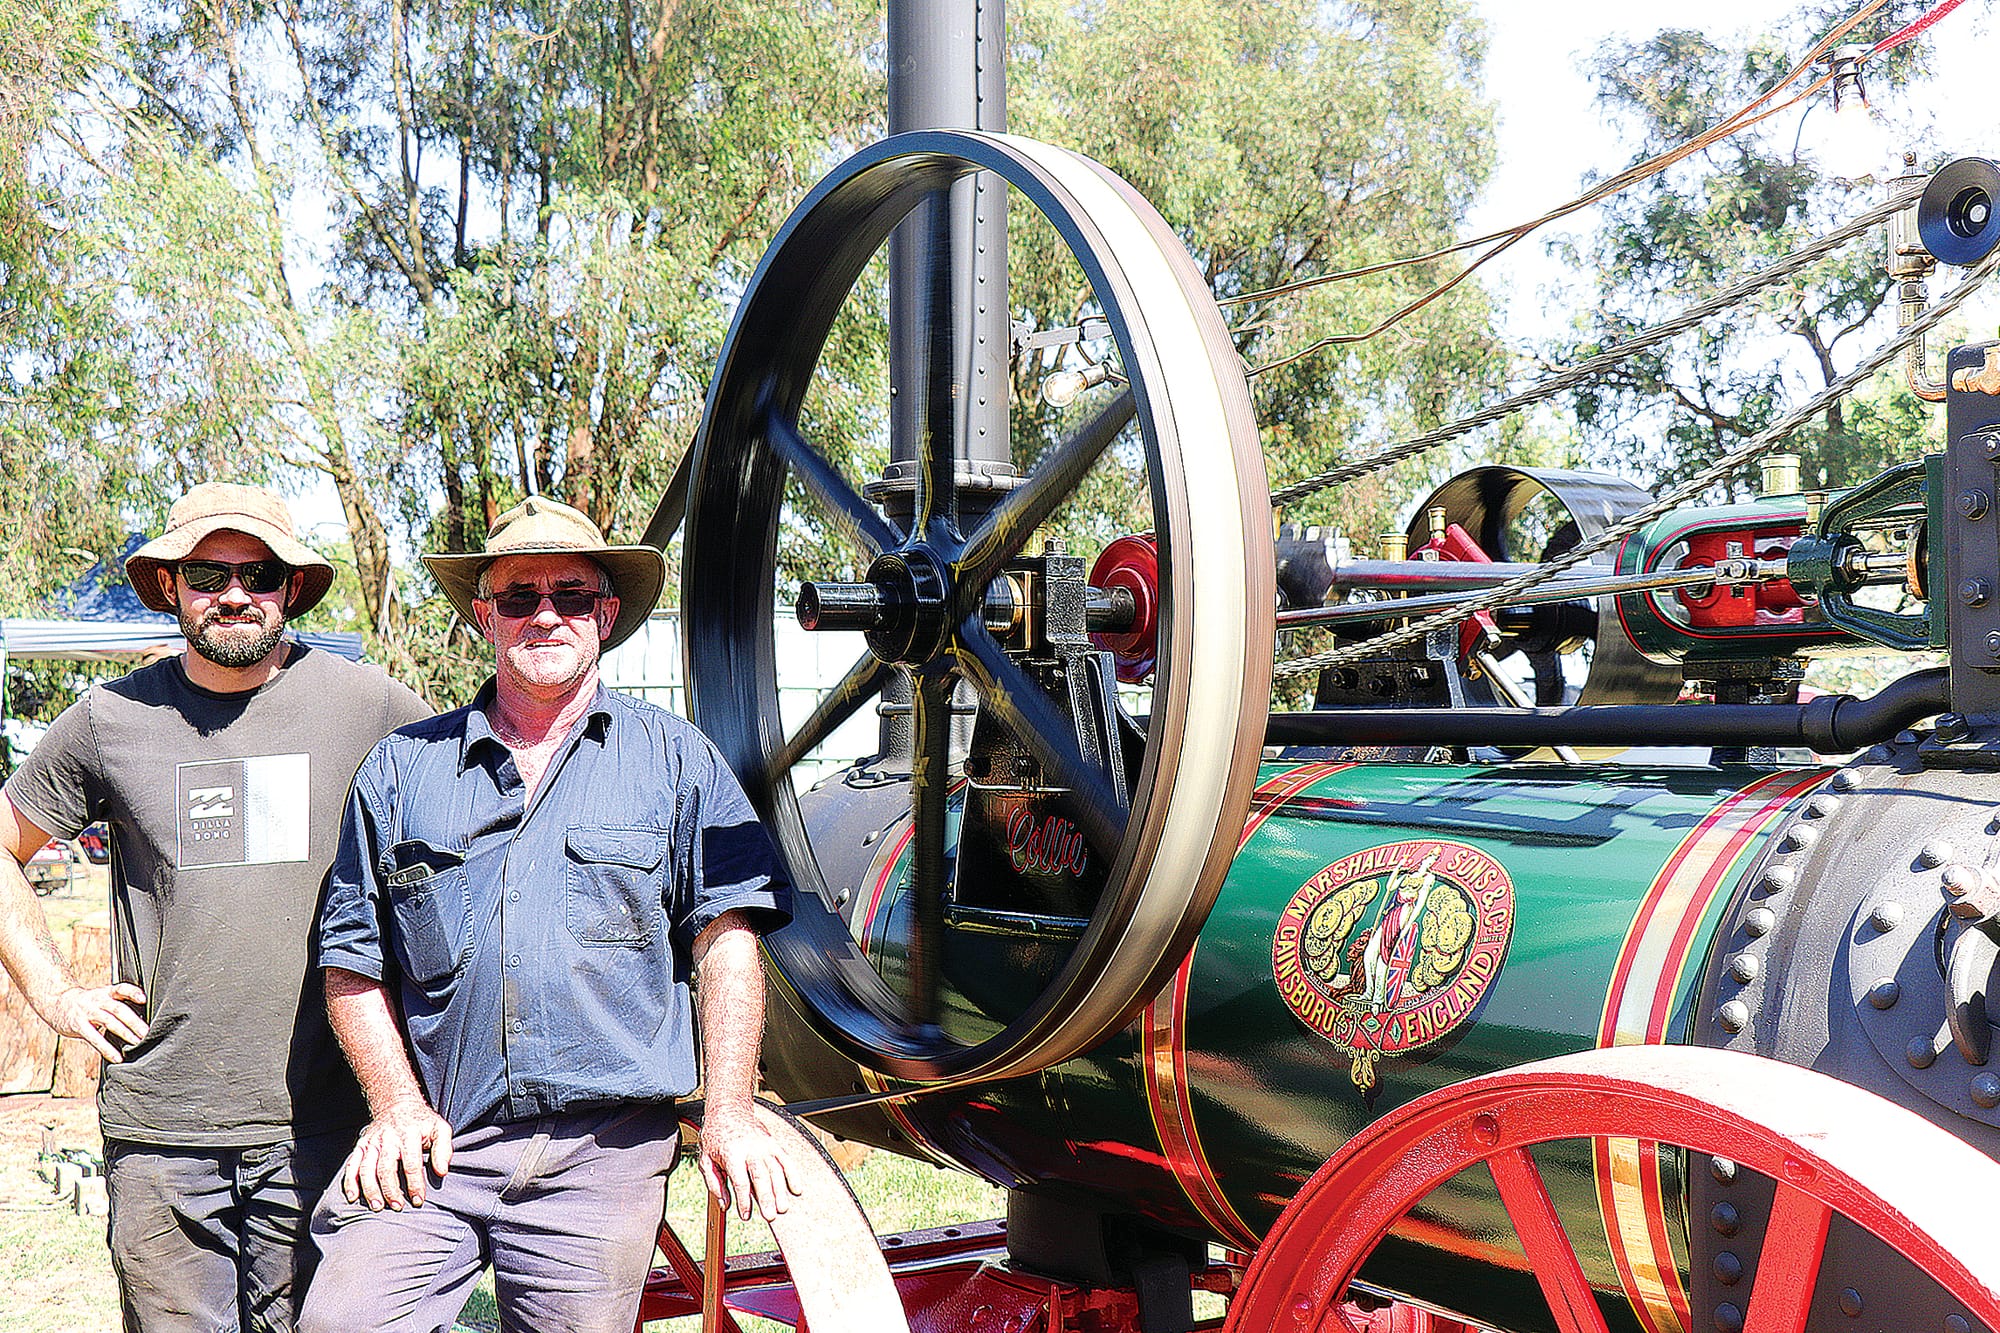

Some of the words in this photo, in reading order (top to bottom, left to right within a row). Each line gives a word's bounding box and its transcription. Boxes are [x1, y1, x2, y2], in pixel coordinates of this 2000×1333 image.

[192, 820, 231, 830] BILLA
[1006, 804, 1087, 877] Collie
[1287, 845, 1402, 920] MARSHALL
[1446, 850, 1499, 892] SONS
[1481, 885, 1508, 912] &
